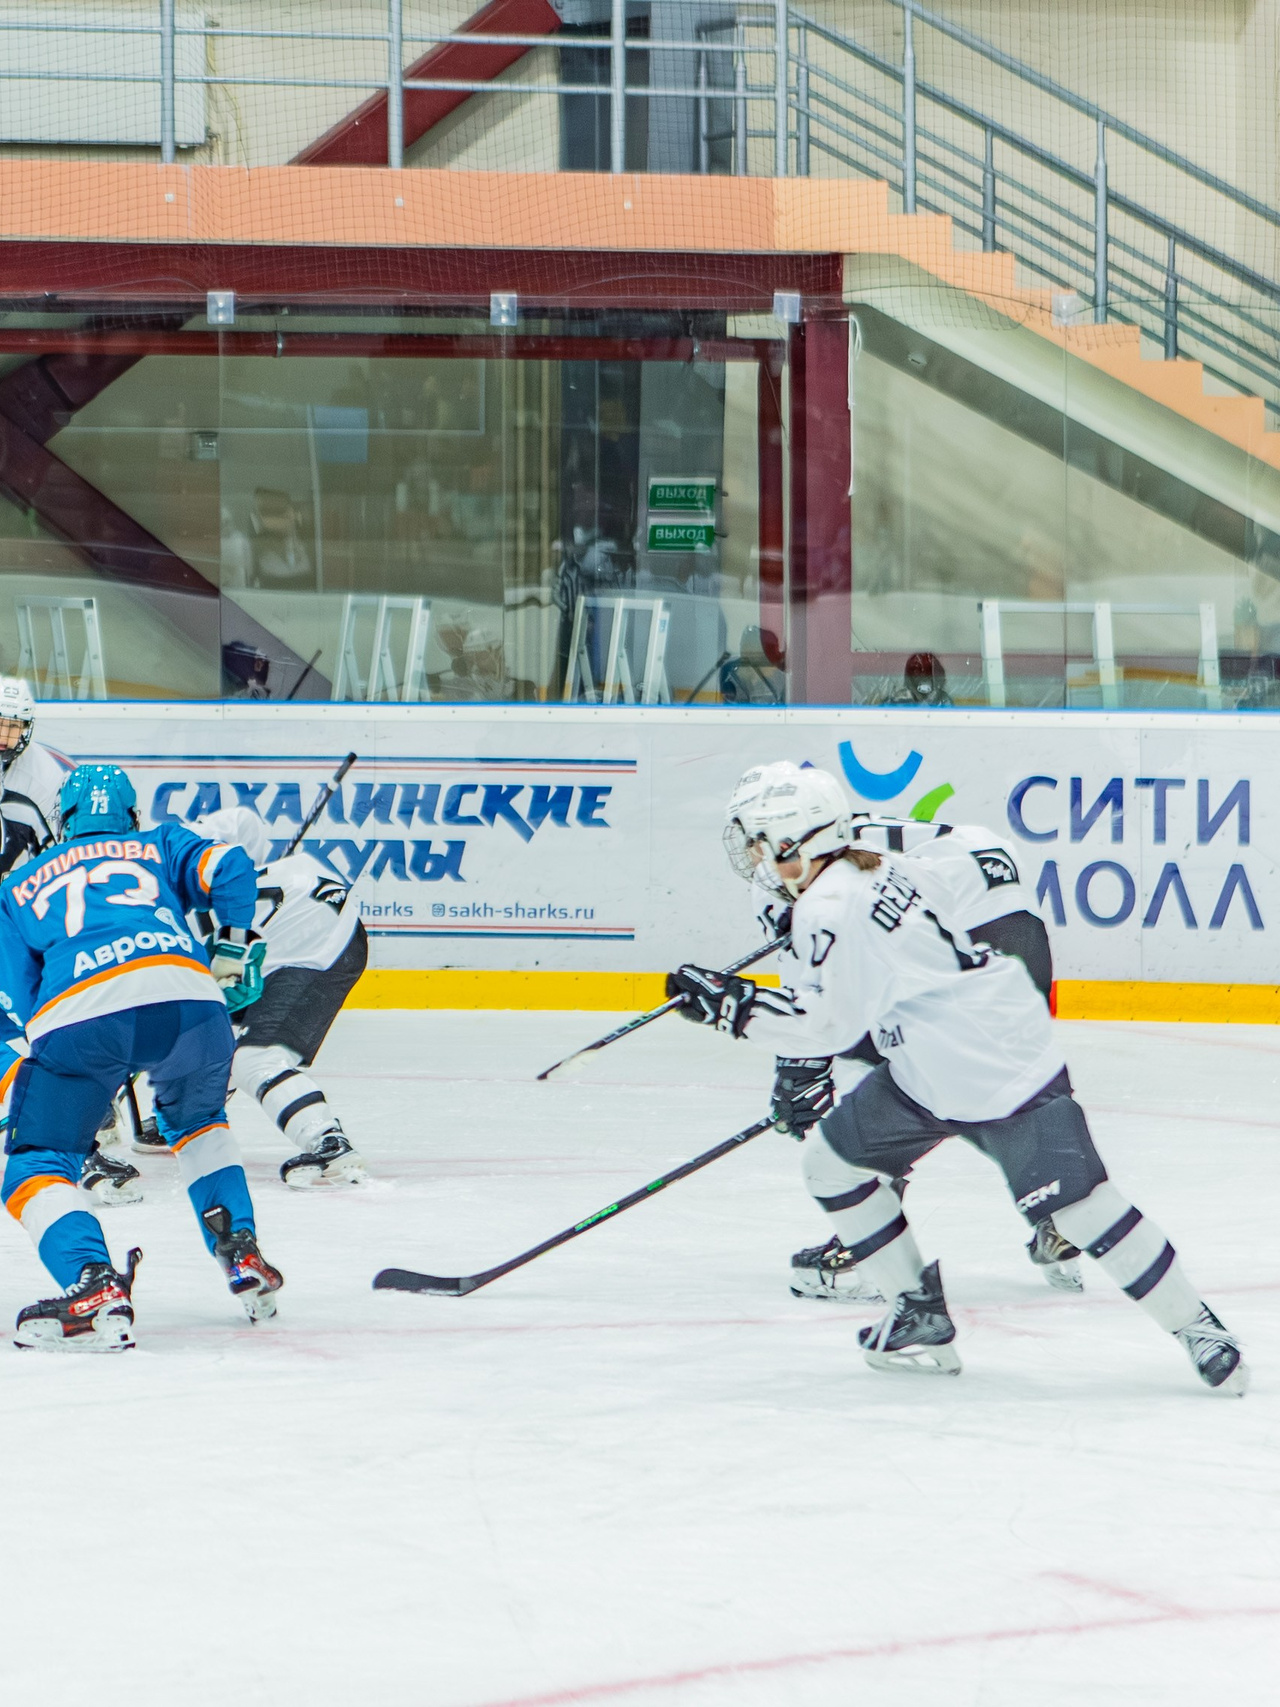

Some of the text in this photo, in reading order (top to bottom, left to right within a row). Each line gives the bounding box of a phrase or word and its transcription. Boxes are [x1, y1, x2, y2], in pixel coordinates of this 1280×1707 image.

[656, 487, 707, 499] ВЫХОД
[655, 527, 706, 540] ВЫХОД
[90, 794, 109, 815] 73
[150, 781, 612, 843] САХАЛИНСКИЕ
[1006, 775, 1251, 846] СИТИ
[12, 840, 162, 907] КУЛИШОВА
[31, 860, 160, 938] 73
[357, 901, 595, 920] harks sakh-sharks.ru
[73, 931, 193, 978] Аврора
